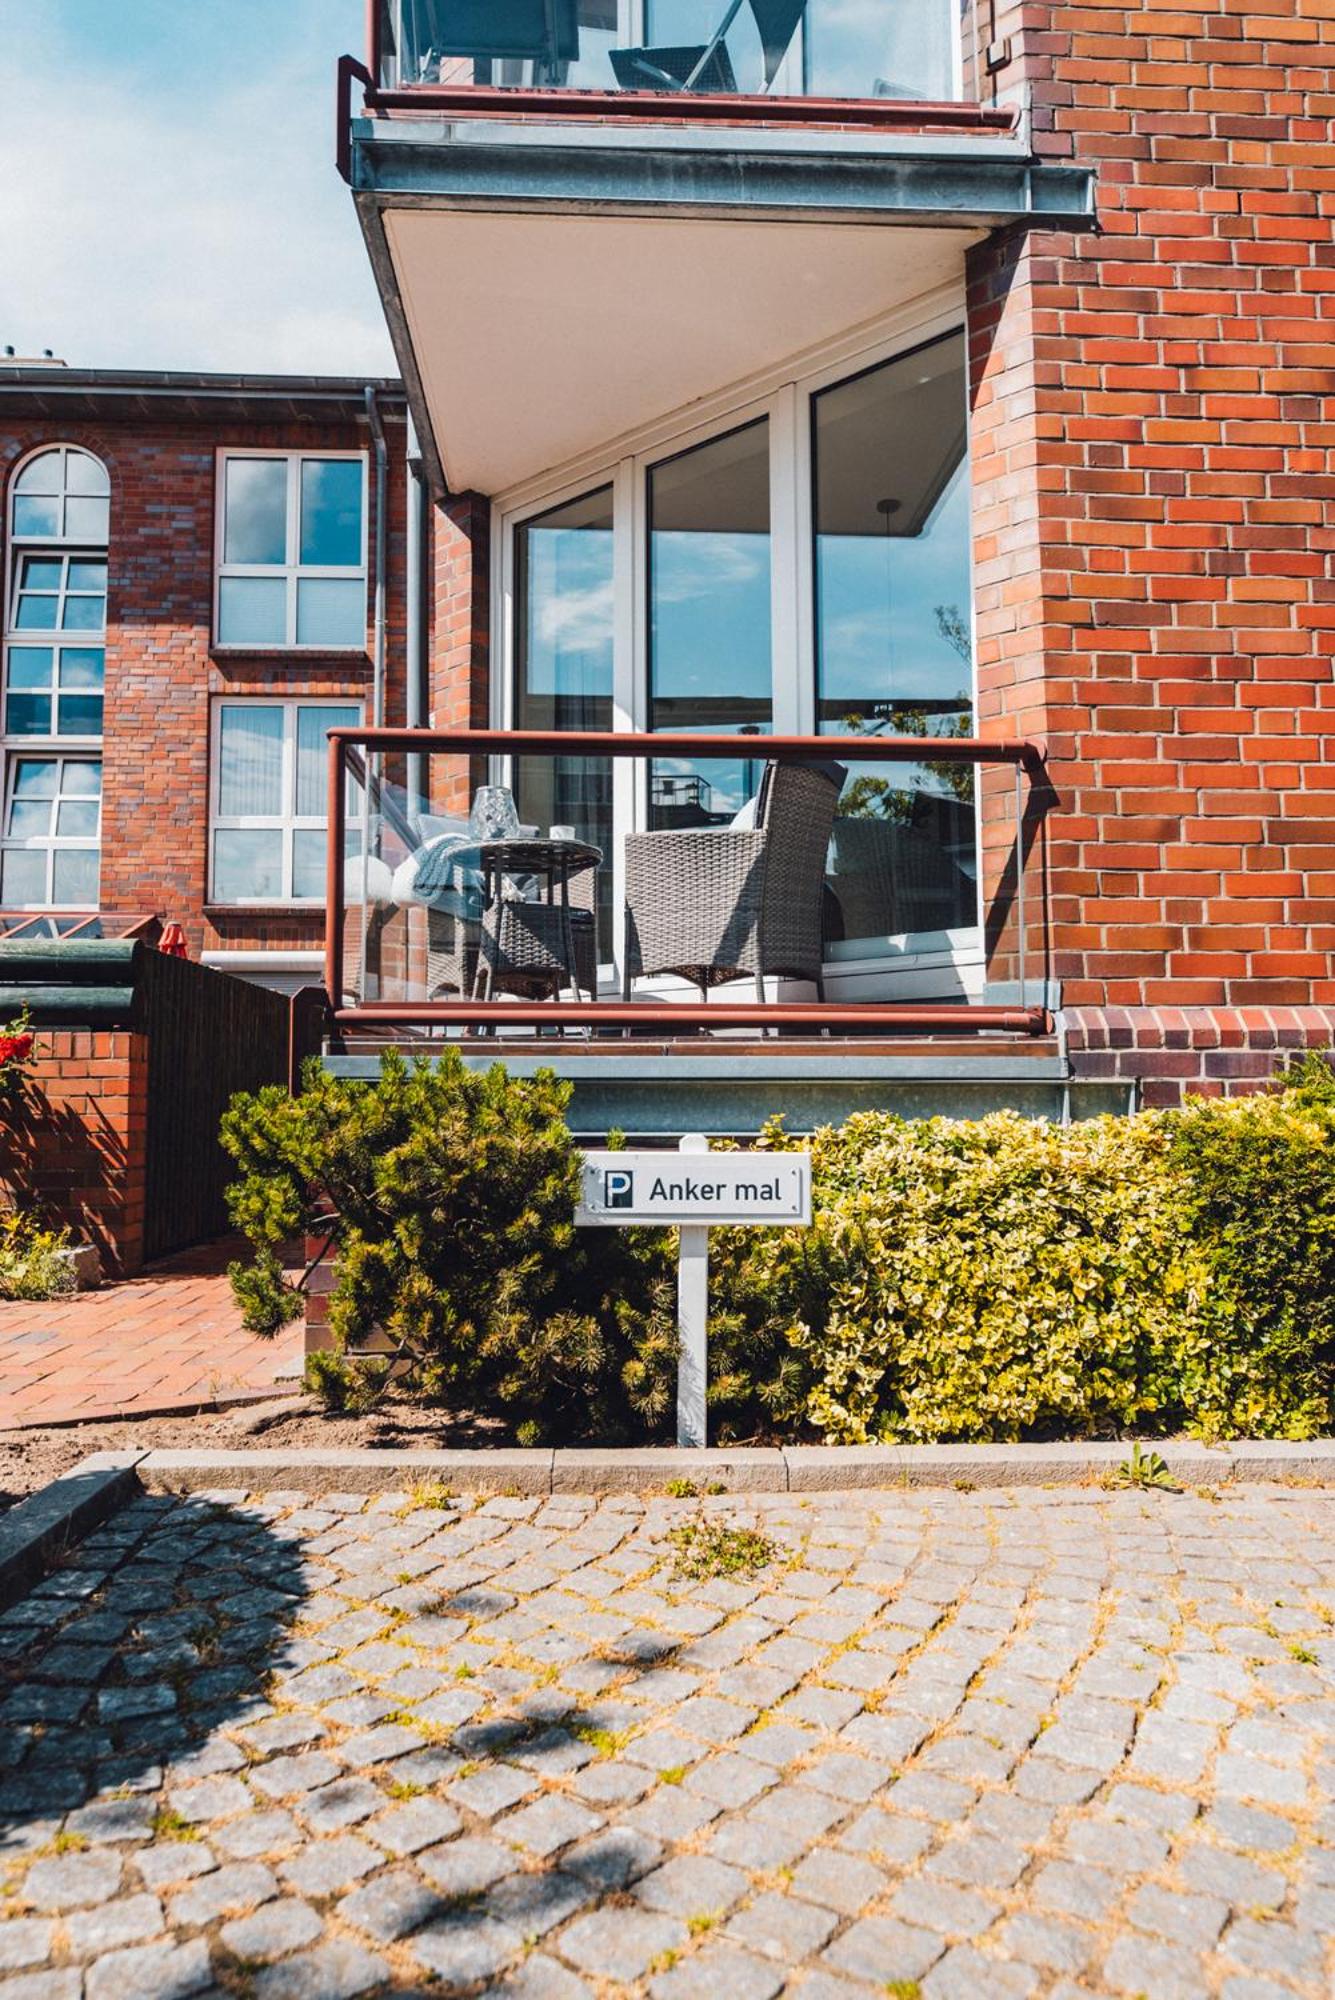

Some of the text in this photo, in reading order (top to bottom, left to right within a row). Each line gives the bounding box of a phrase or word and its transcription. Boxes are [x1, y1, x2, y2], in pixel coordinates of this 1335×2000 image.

[606, 1172, 782, 1206] P Anker mal
